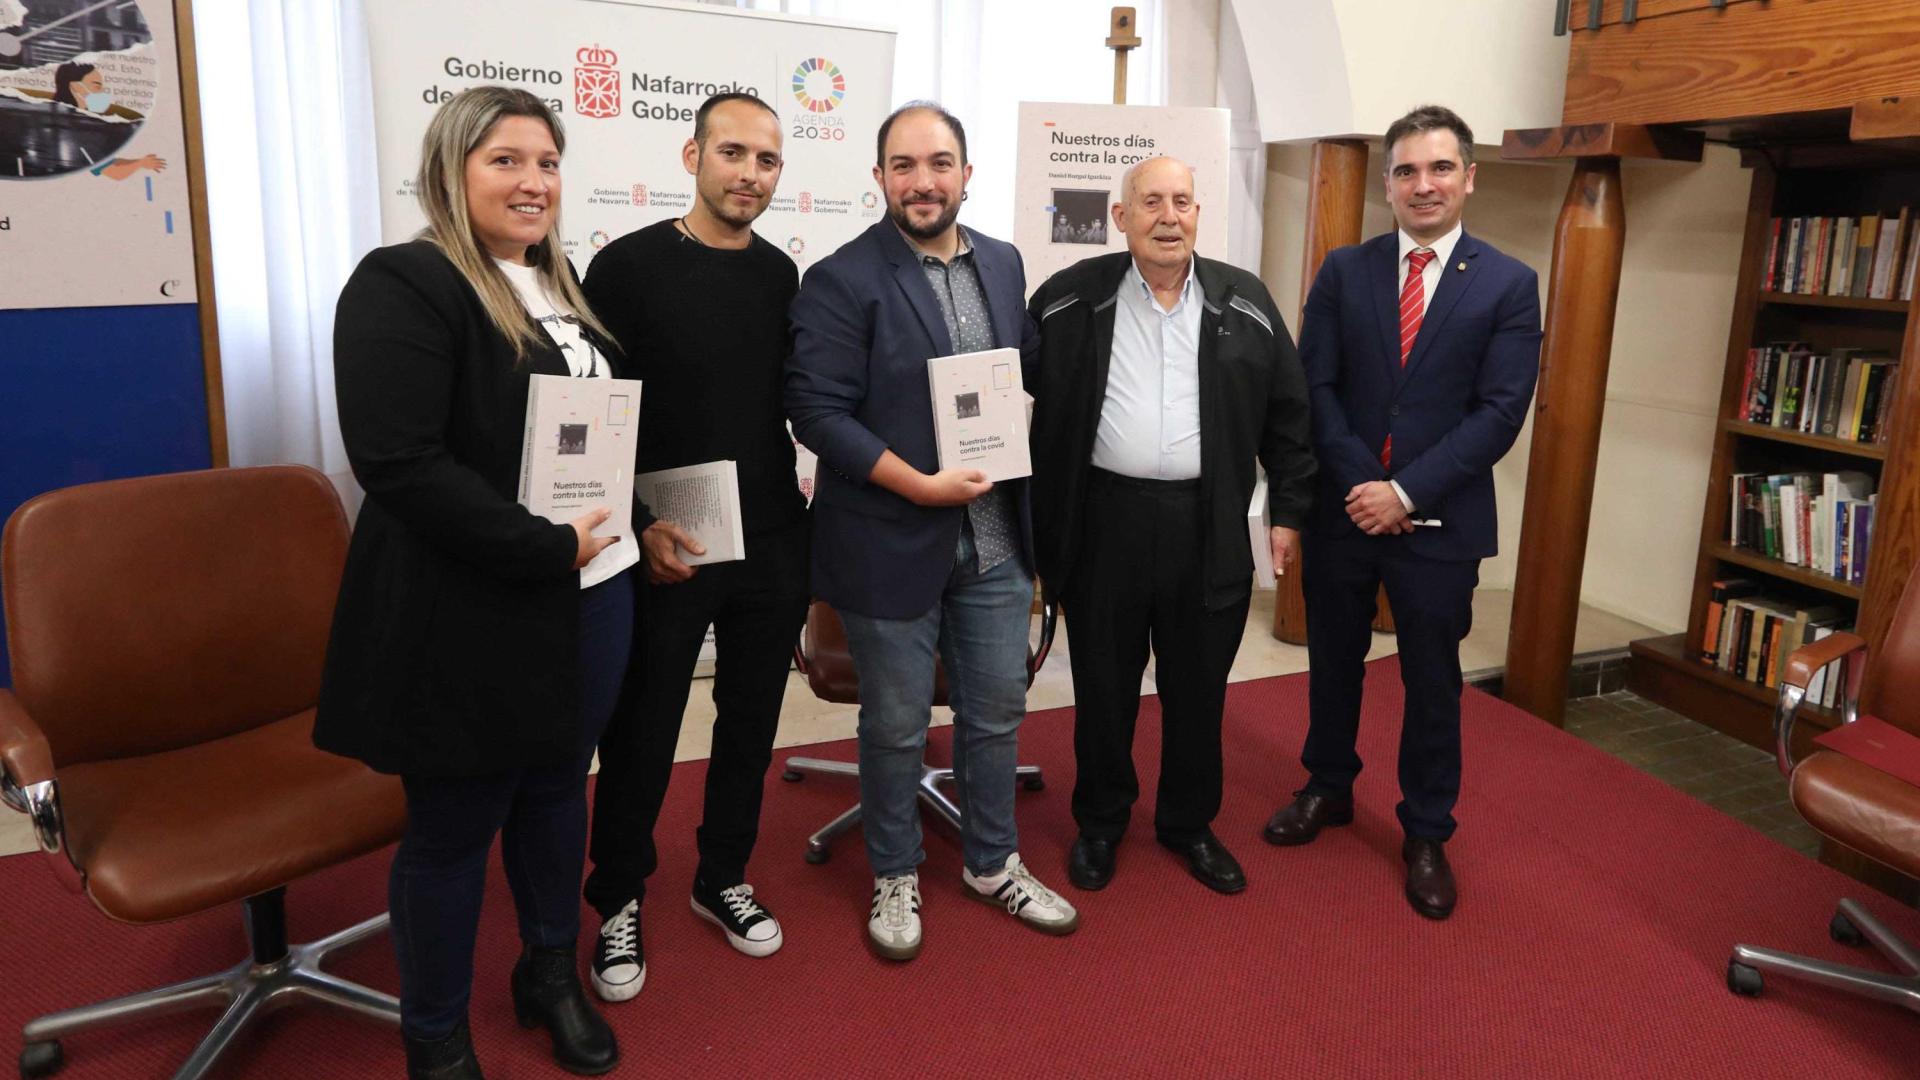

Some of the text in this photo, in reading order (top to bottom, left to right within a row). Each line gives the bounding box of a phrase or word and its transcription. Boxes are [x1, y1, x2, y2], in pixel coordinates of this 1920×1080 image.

[444, 57, 563, 85] Gobierno
[632, 72, 759, 99] Nafarroako
[792, 113, 846, 128] AGENDA
[792, 125, 845, 141] 2030
[1051, 131, 1155, 148] Nuestros días
[1049, 151, 1100, 164] contra
[1103, 150, 1116, 164] la
[593, 188, 630, 197] Gobierno
[650, 191, 691, 200] Nafarroako
[599, 197, 630, 205] Navarra
[650, 199, 687, 208] Gobernua
[959, 438, 986, 447] Nuestros
[960, 446, 980, 454] contra
[987, 442, 1005, 450] covid
[553, 481, 587, 490] Nuestros
[552, 492, 577, 500] contra
[585, 490, 606, 498] covid
